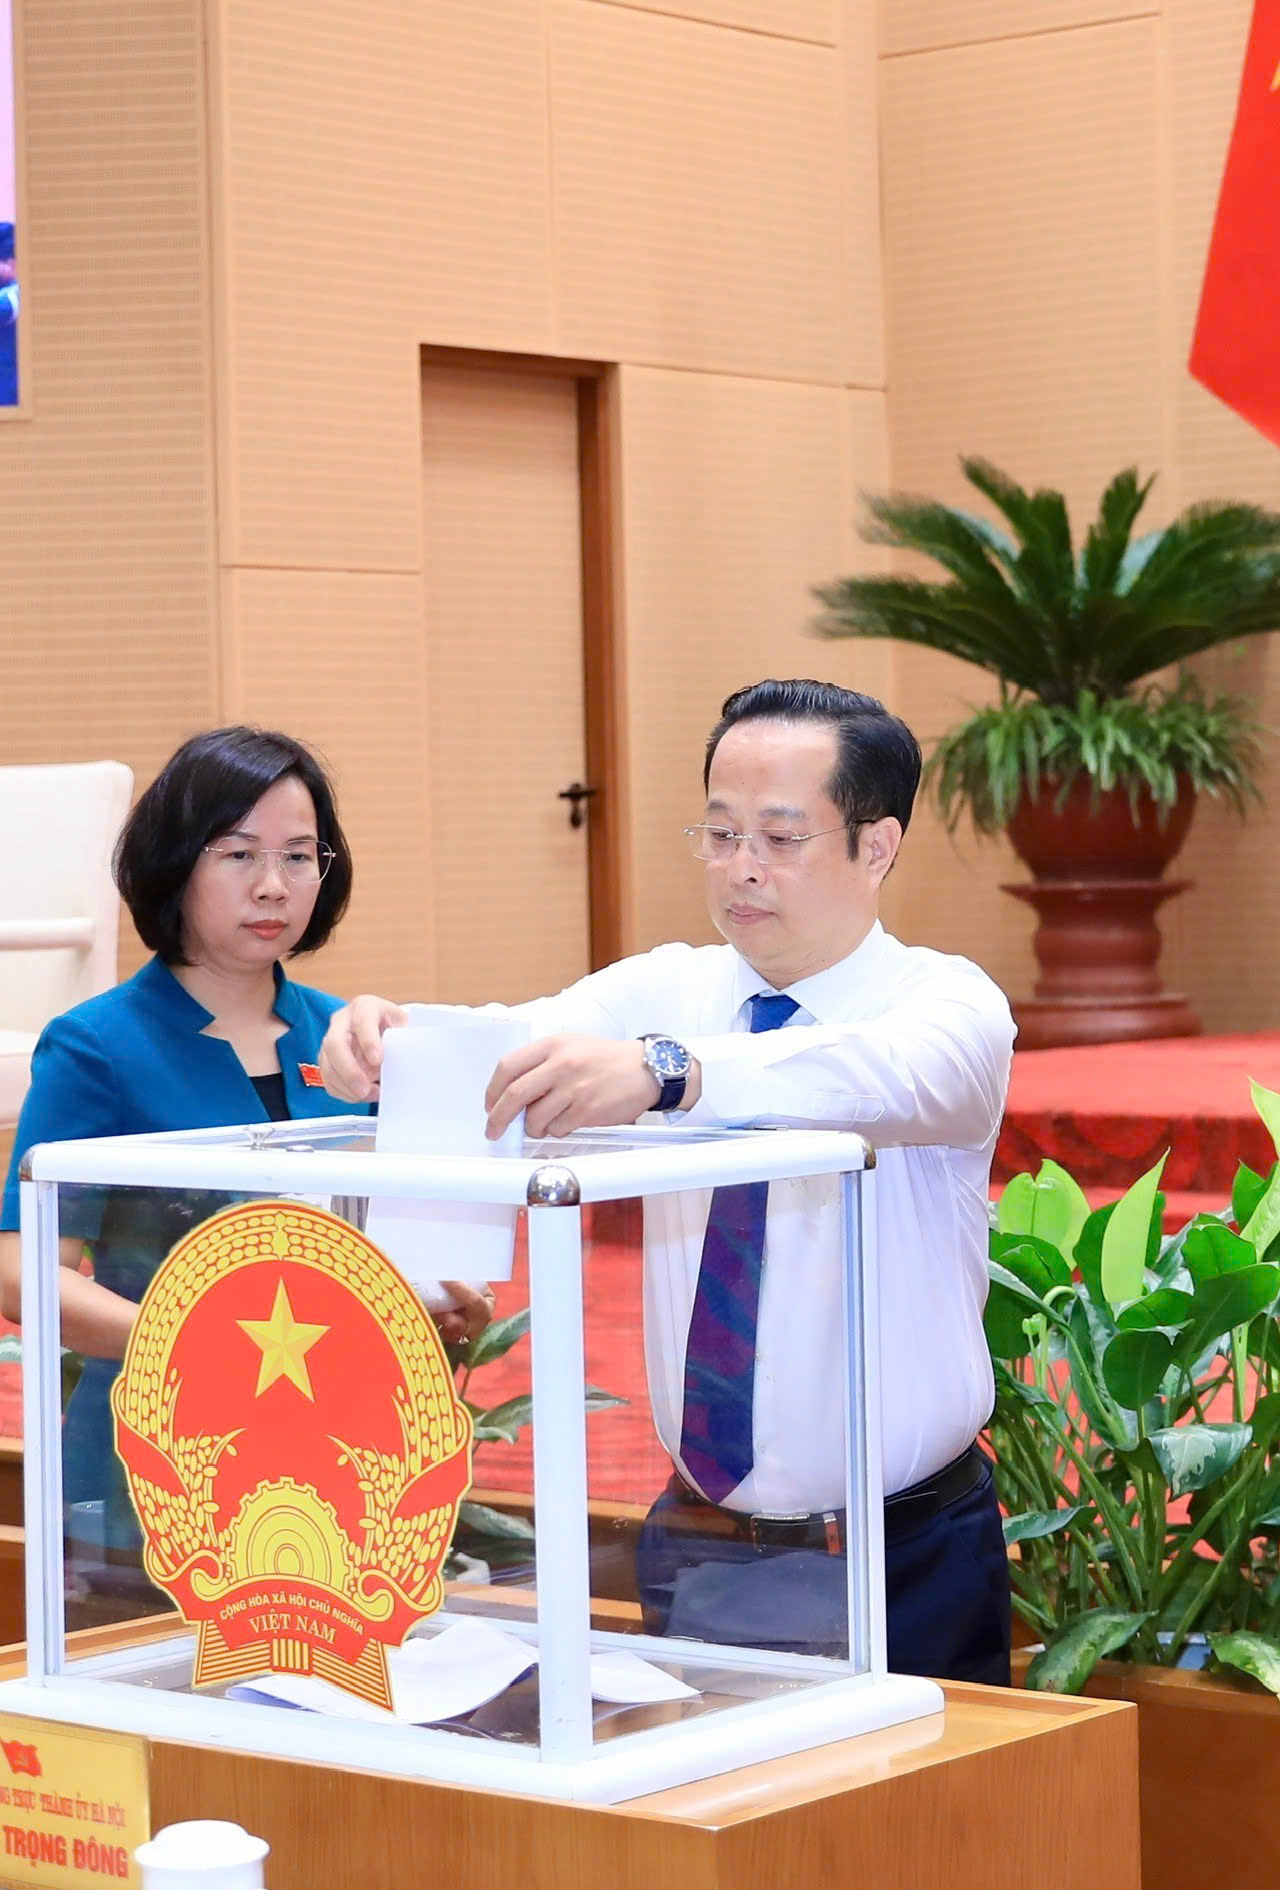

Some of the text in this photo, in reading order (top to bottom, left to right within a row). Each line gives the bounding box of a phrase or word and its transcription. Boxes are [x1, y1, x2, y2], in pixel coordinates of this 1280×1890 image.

[219, 1591, 364, 1635] CỘNG HÒA XÃ HỘI CHỦ NGHĨA
[248, 1608, 337, 1644] VIỆT NAM
[2, 1824, 67, 1867] TRỌNG
[73, 1835, 129, 1879] ĐÔNG
